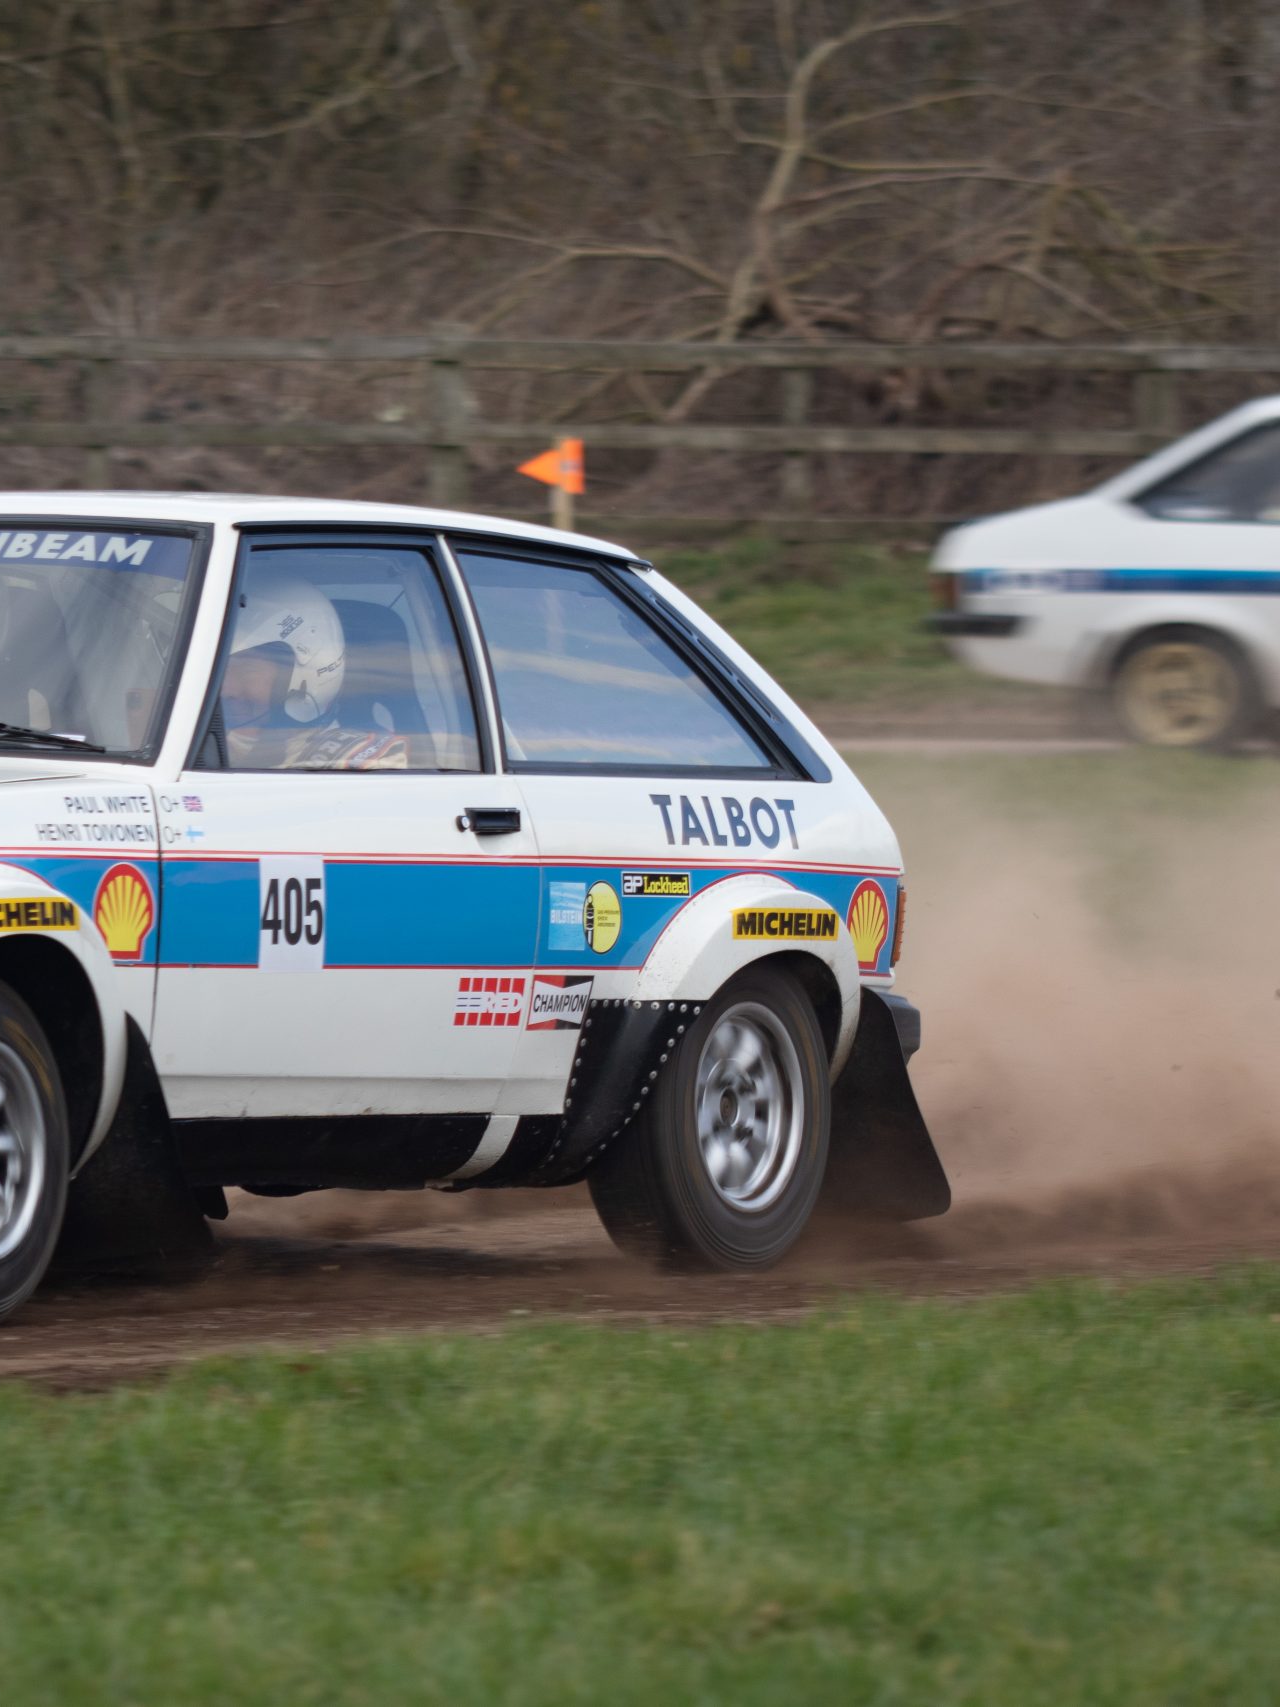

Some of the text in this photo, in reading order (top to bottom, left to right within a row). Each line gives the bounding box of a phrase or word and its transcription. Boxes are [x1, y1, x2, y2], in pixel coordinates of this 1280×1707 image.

[64, 796, 103, 813] PAUL
[103, 796, 151, 813] WHITE
[649, 793, 799, 850] TALBOT
[35, 823, 81, 842] HENRI
[83, 823, 156, 842] TOIVONEN
[643, 875, 689, 894] Lockheed
[261, 877, 322, 946] 405
[736, 912, 836, 937] MICHELIN
[532, 993, 588, 1013] CHAMPION
